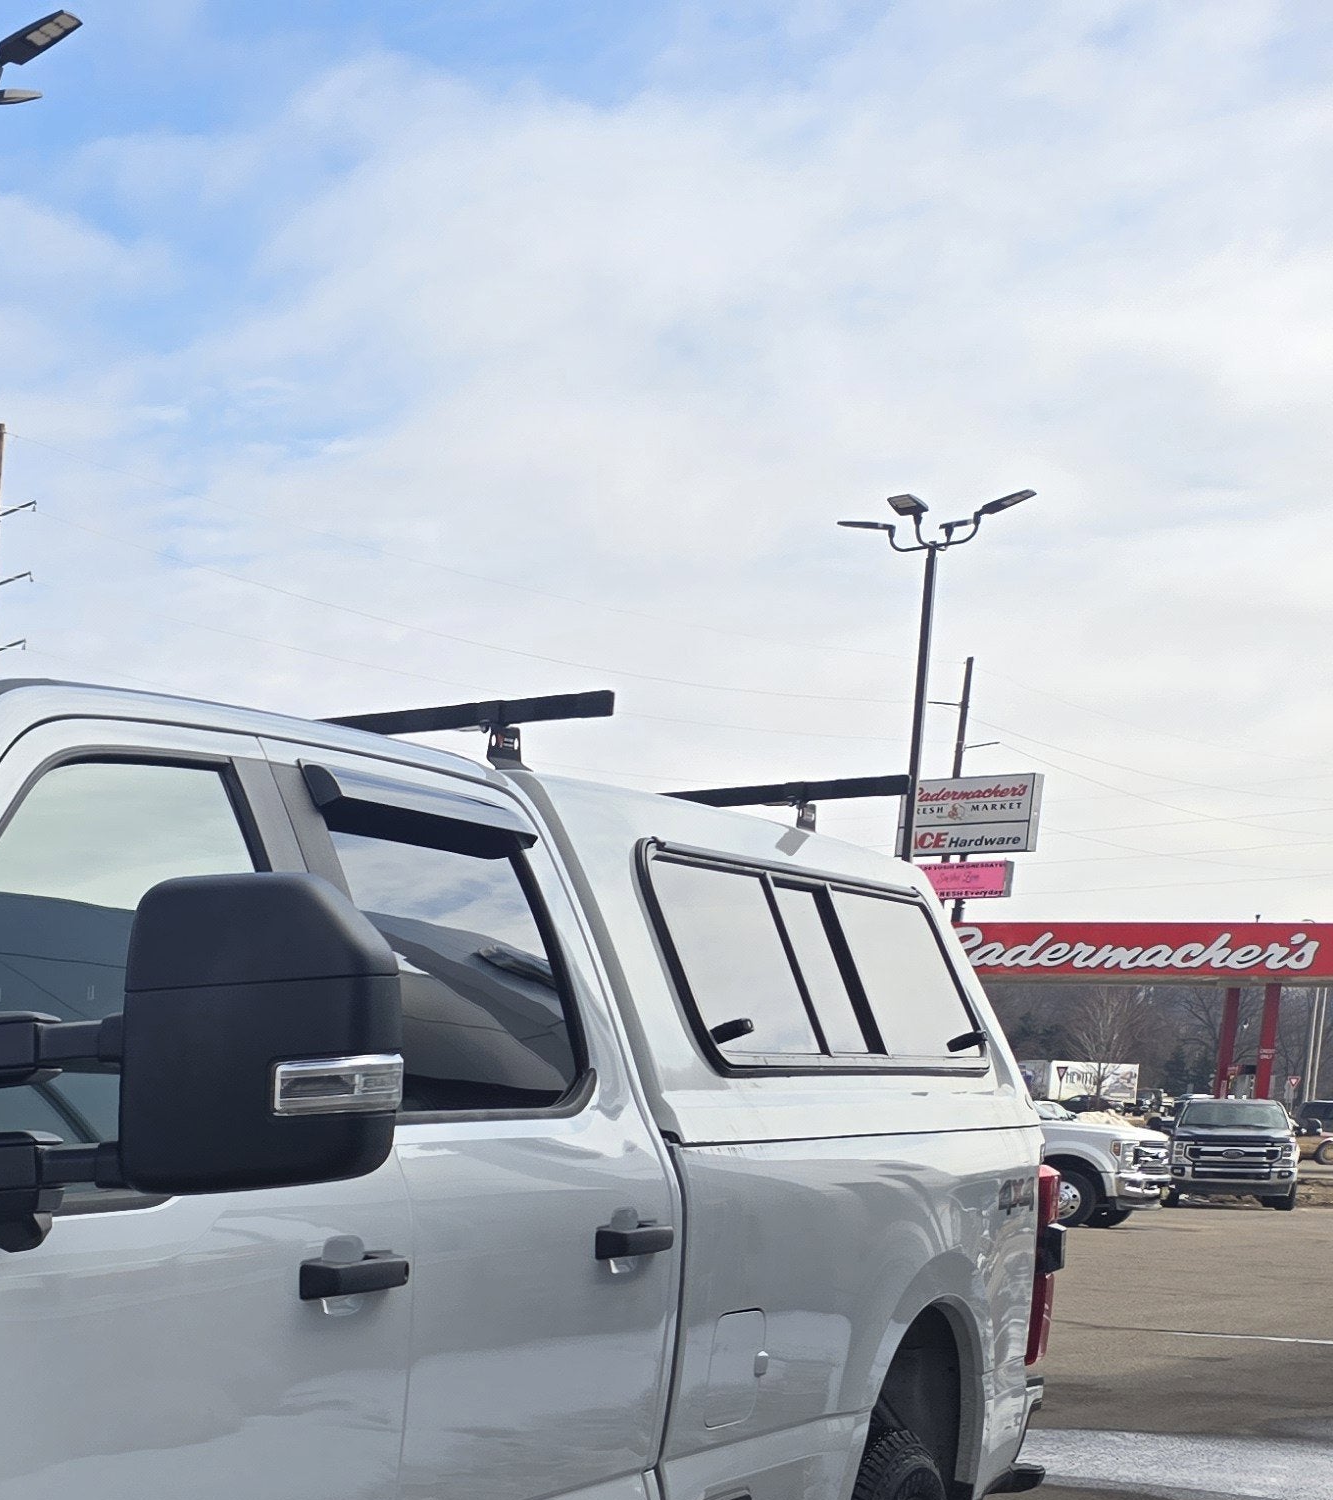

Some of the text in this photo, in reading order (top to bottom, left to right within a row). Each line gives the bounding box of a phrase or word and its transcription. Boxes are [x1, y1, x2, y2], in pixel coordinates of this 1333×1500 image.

[917, 801, 1023, 815] RESH MARKET
[948, 835, 1022, 849] Hardware
